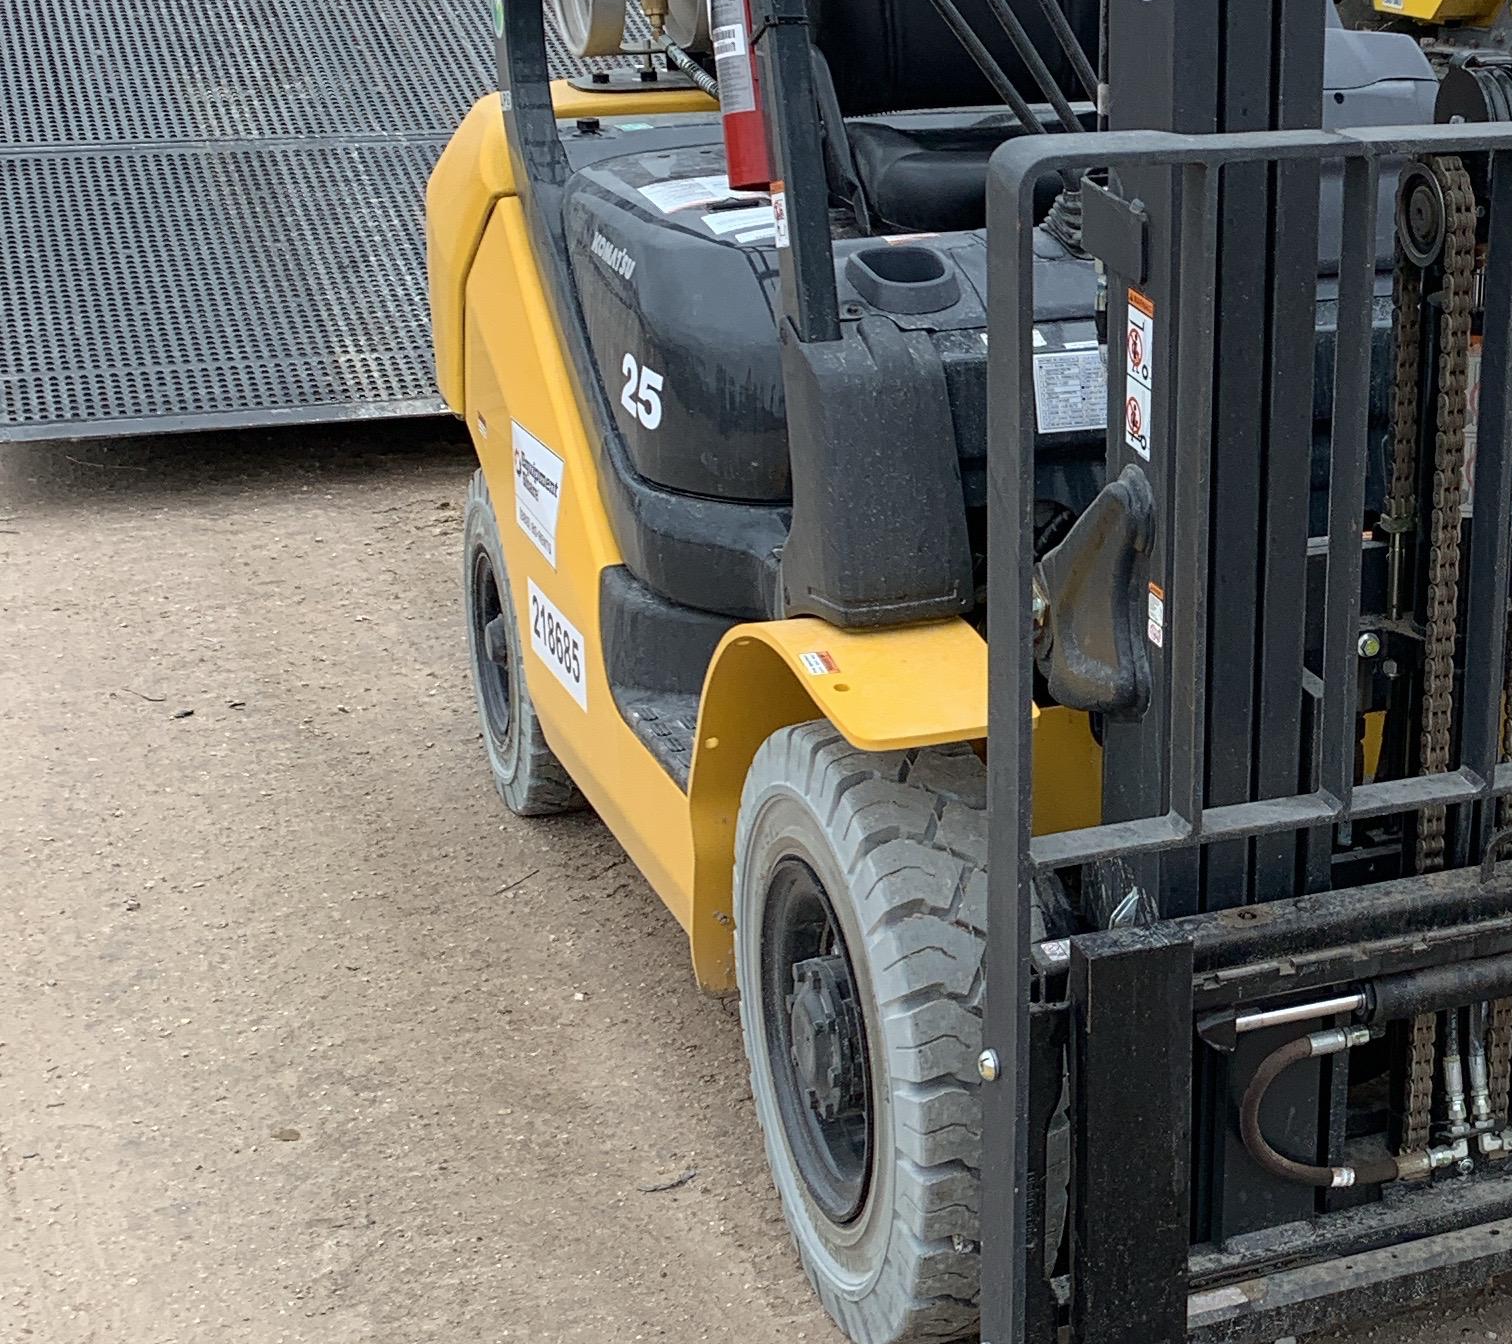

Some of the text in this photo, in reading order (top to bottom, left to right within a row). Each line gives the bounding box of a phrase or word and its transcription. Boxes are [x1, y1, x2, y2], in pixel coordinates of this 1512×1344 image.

[590, 231, 636, 280] KOMATSU
[620, 353, 664, 430] 25
[531, 594, 580, 684] 218685
